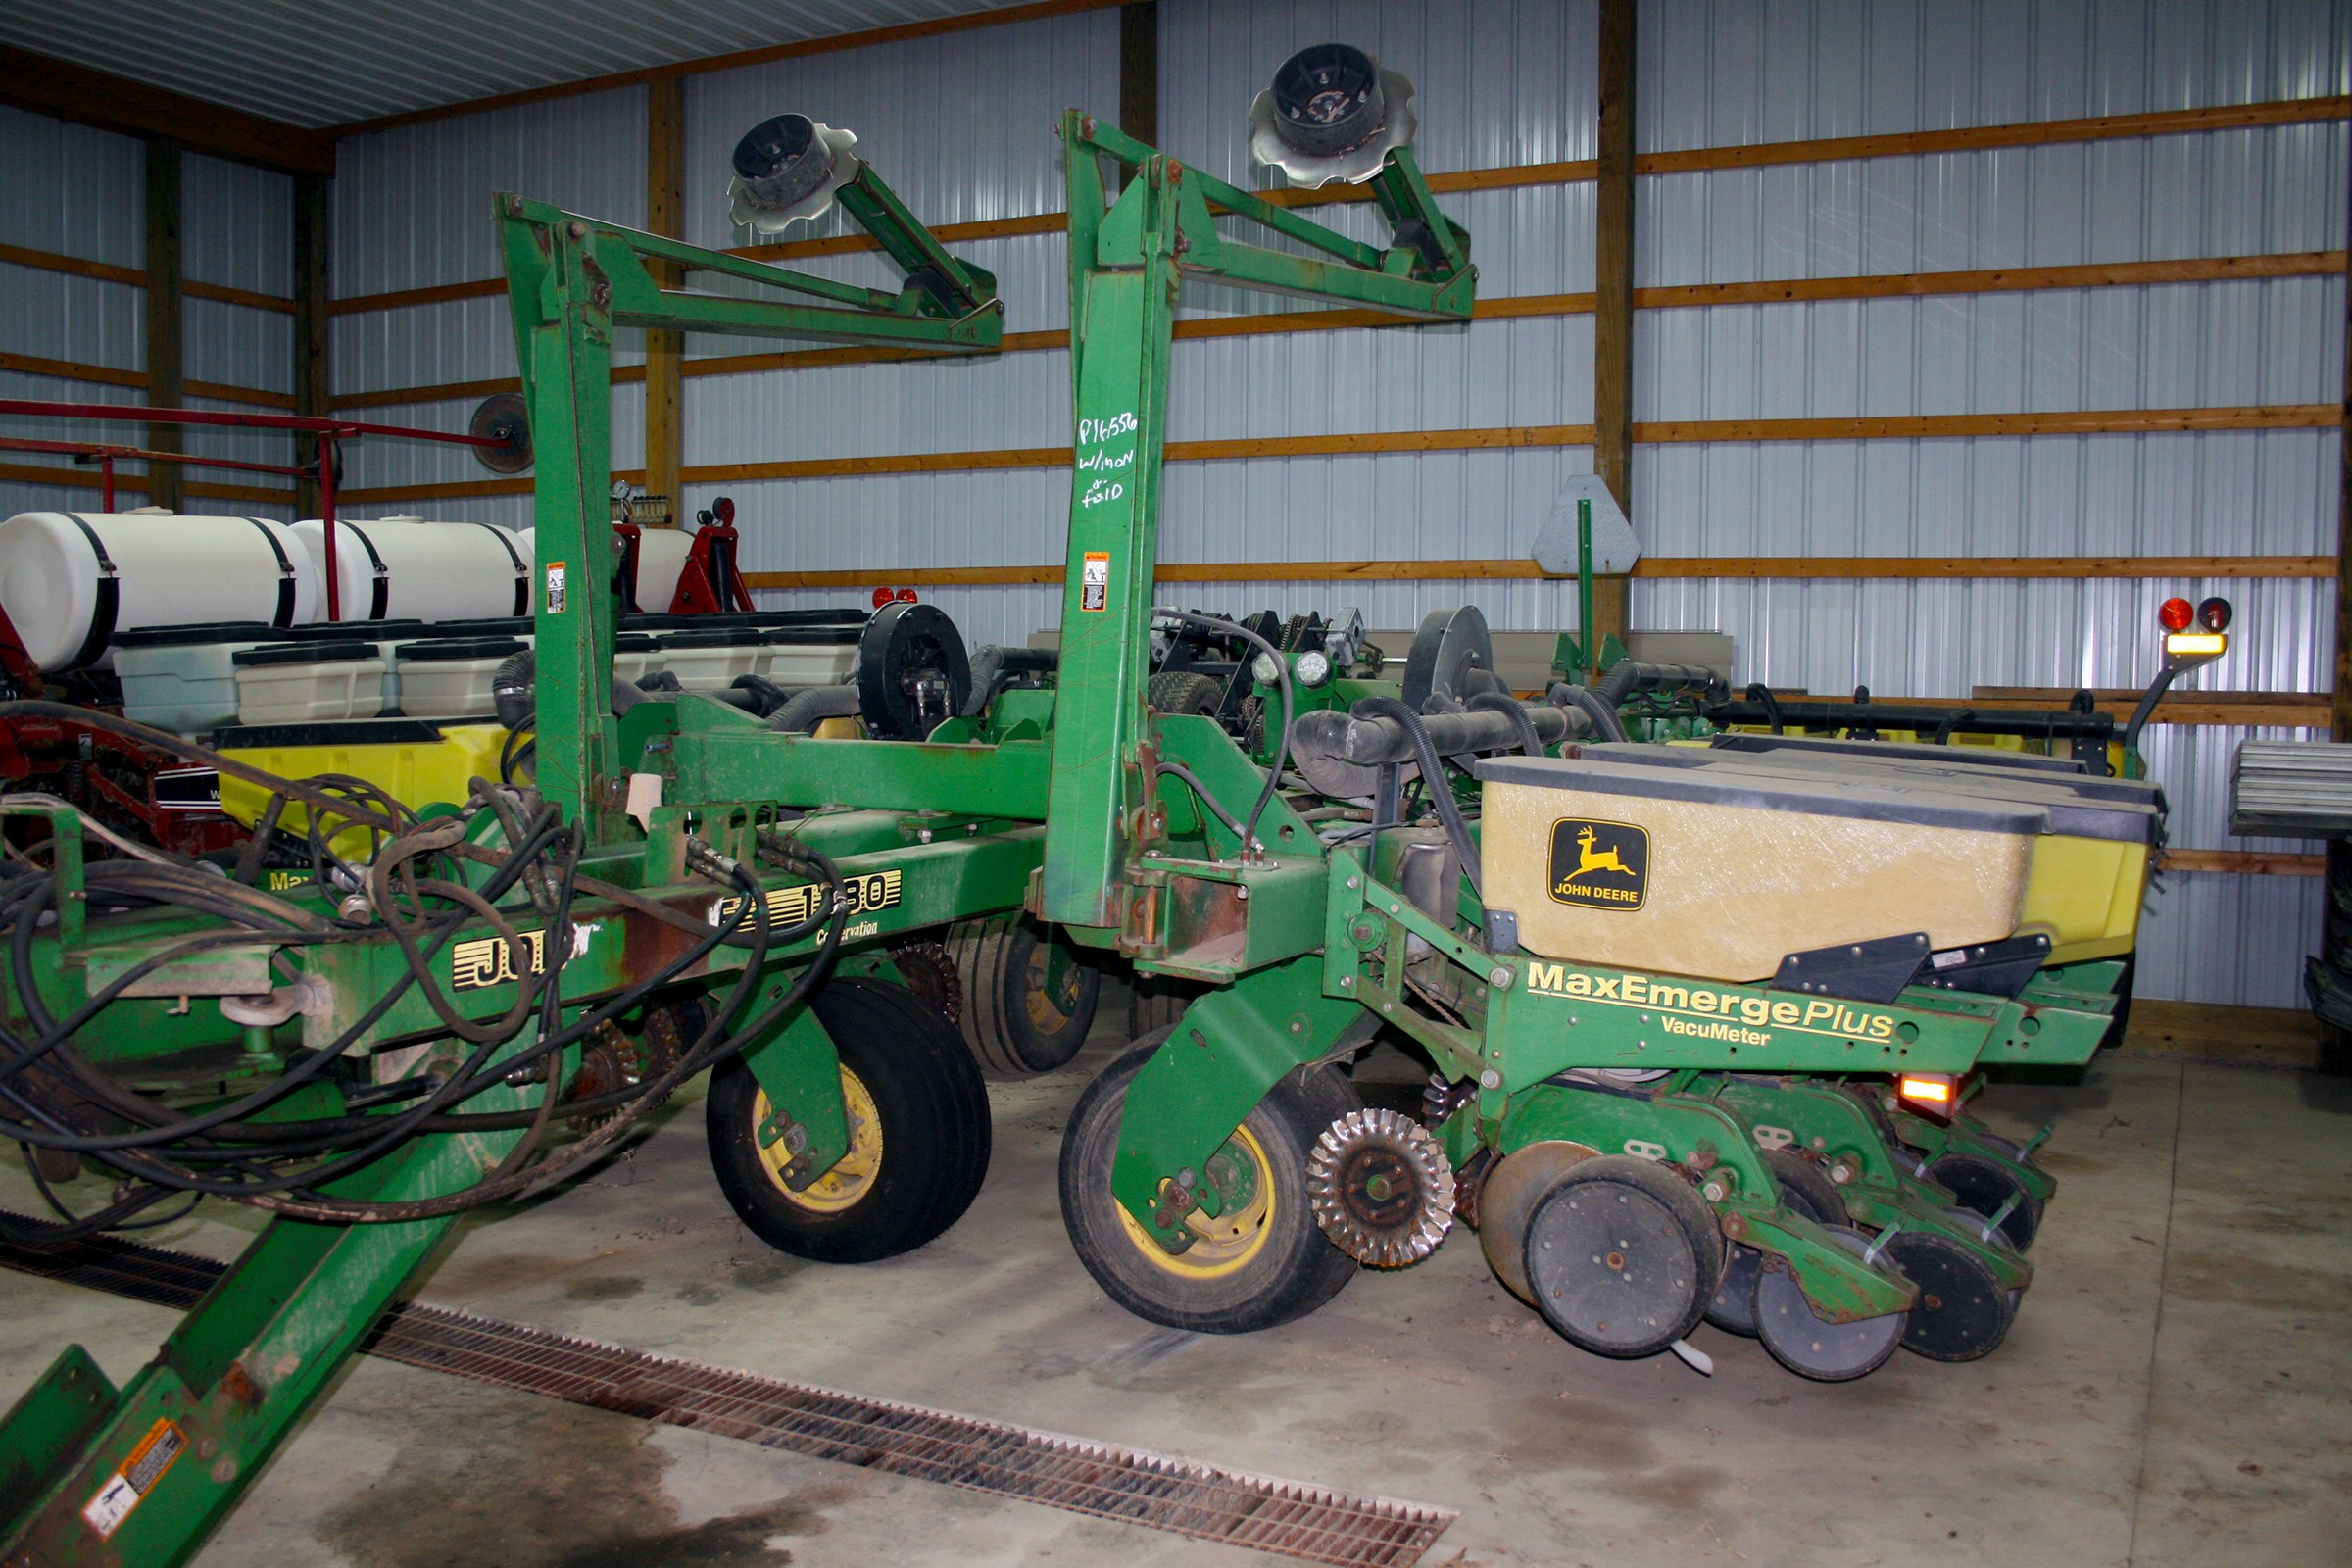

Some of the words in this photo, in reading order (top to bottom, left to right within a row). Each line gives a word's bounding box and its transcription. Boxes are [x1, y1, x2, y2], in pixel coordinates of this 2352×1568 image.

[800, 874, 887, 921] 180
[1554, 882, 1592, 897] JOHN
[1593, 886, 1639, 903] DEERE
[1660, 1015, 1772, 1047] VacuMeter
